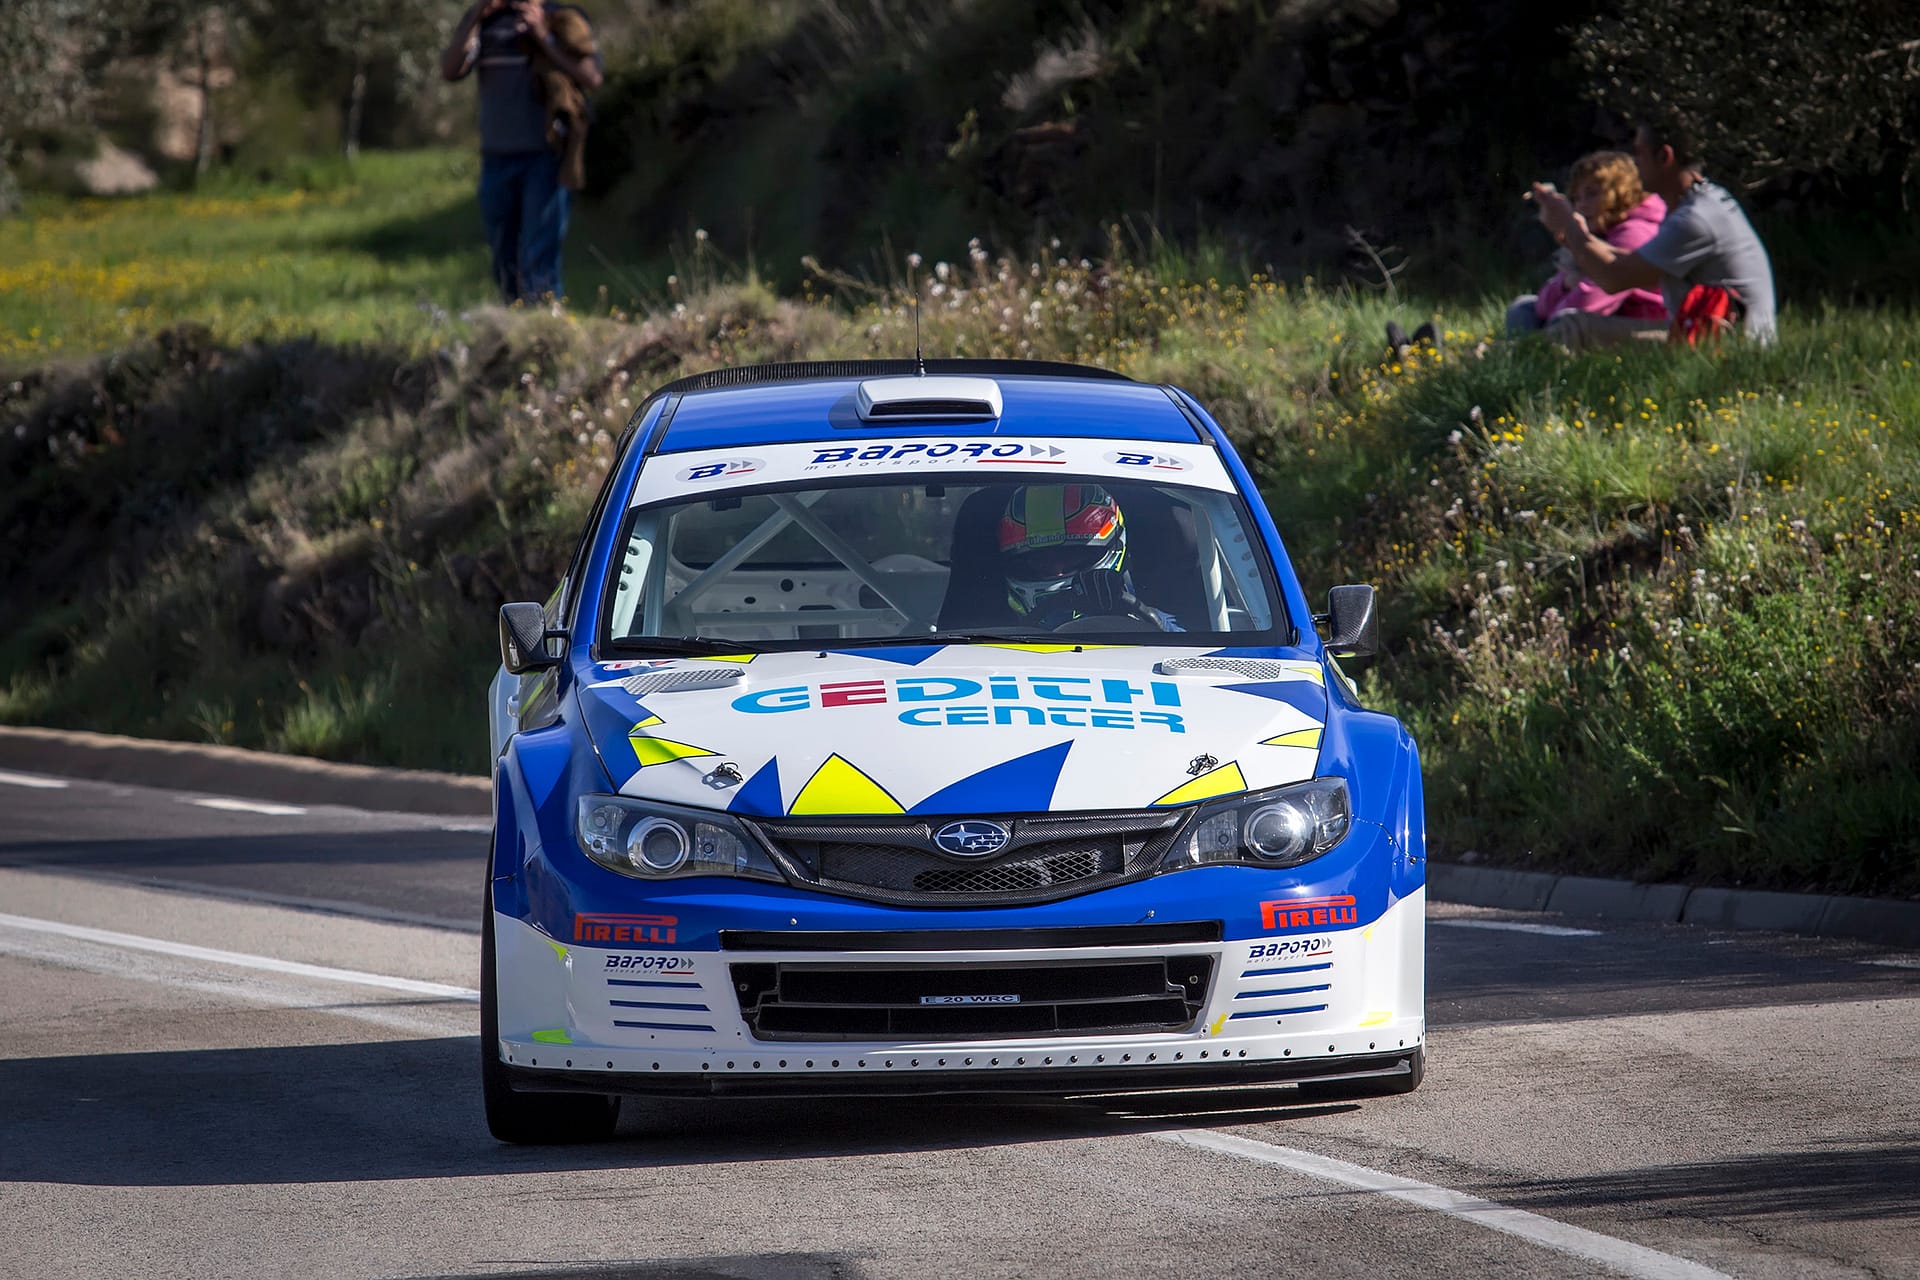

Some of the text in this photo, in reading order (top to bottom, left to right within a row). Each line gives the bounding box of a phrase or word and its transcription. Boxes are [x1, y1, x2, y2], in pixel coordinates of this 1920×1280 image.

[803, 458, 969, 471] motorsport
[1260, 895, 1357, 929] PIRELLI
[574, 913, 678, 943] PIRELLI
[943, 996, 964, 1004] 20
[970, 994, 1014, 1003] WRC
